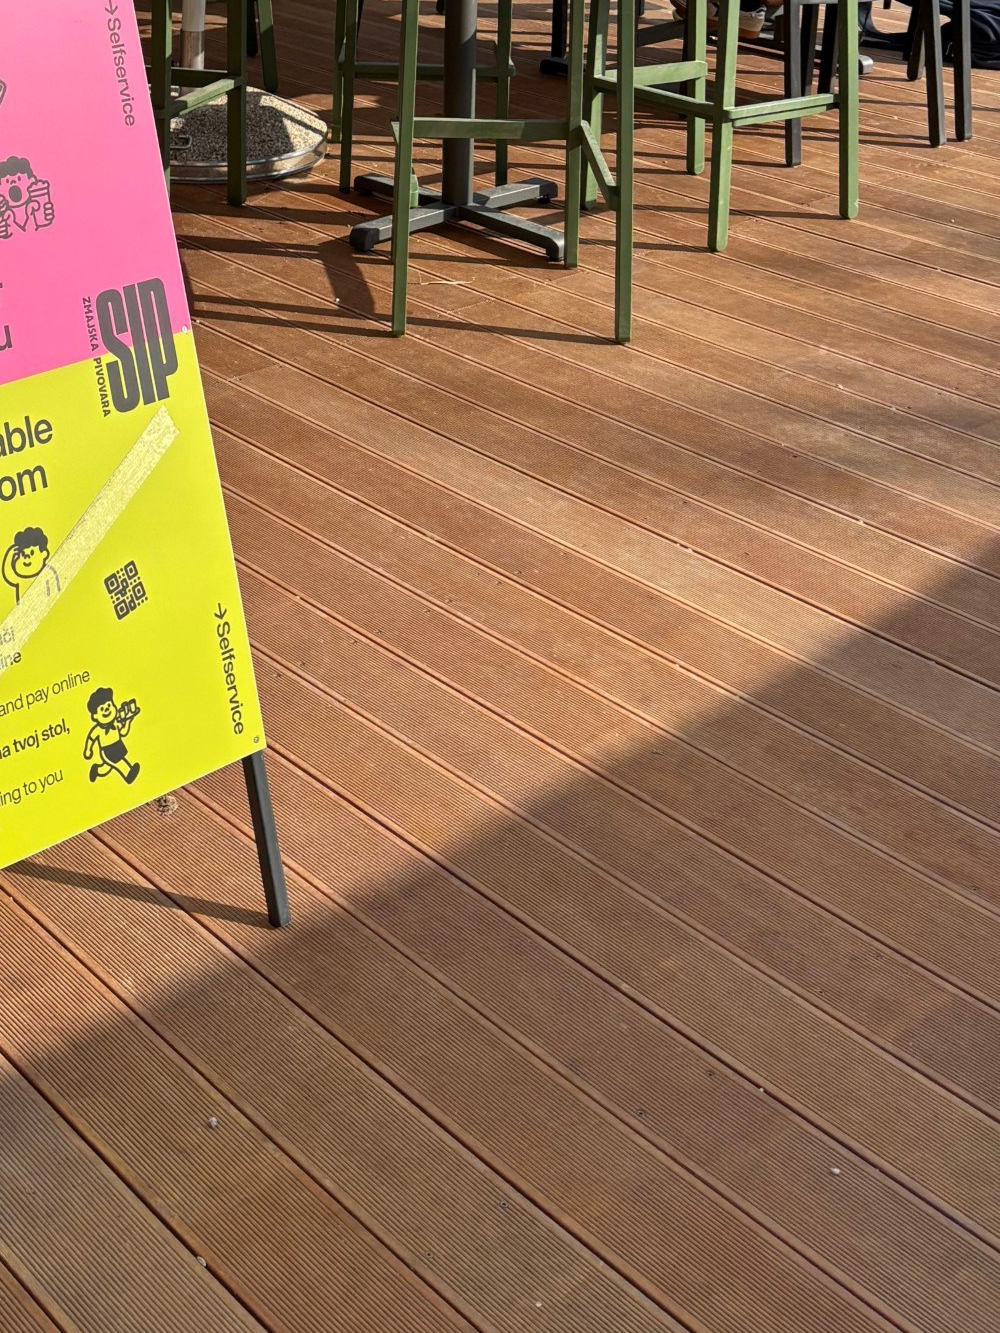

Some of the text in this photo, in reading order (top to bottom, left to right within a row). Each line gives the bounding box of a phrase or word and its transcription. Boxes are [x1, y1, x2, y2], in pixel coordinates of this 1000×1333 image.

[107, 17, 135, 126] Selfservice
[82, 296, 111, 417] ZMAJSKA PIVOVARA
[95, 277, 178, 413] SIP
[25, 686, 50, 710] pay
[51, 670, 90, 695] online
[216, 621, 244, 735] Selfservice
[12, 729, 40, 753] tvoj
[40, 717, 71, 742] stol,
[22, 781, 38, 796] to
[38, 769, 64, 794] you
